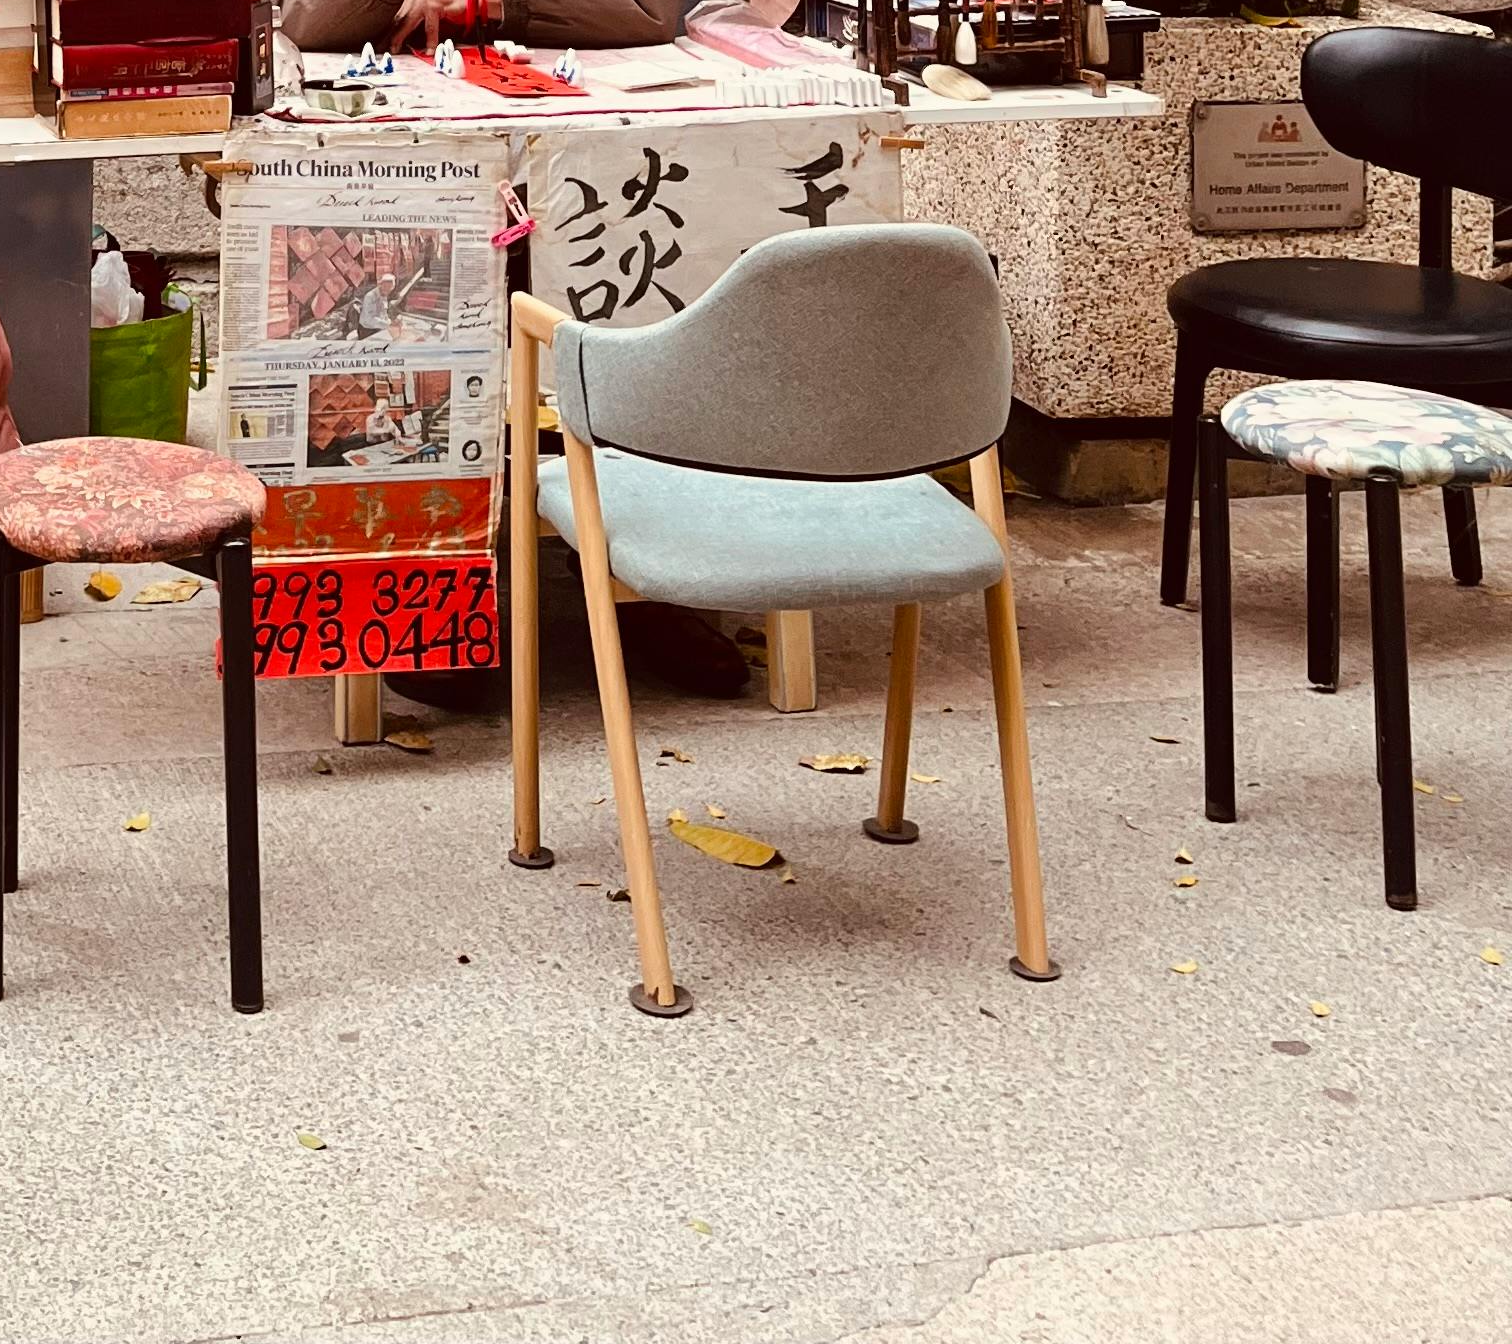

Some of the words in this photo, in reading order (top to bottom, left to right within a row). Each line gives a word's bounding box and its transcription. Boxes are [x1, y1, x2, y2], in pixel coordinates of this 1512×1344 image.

[296, 159, 354, 178] China
[358, 160, 438, 182] Morning
[441, 161, 481, 179] Post
[1209, 184, 1242, 195] Home
[1246, 182, 1282, 195] Affairs
[1285, 181, 1350, 196] Department
[362, 213, 403, 224] LEADING
[404, 214, 427, 224] THE
[428, 214, 457, 224] NEWS
[321, 360, 369, 371] JANUARY
[251, 569, 343, 620] 993
[372, 567, 495, 617] 3277
[251, 611, 497, 676] 9930448
